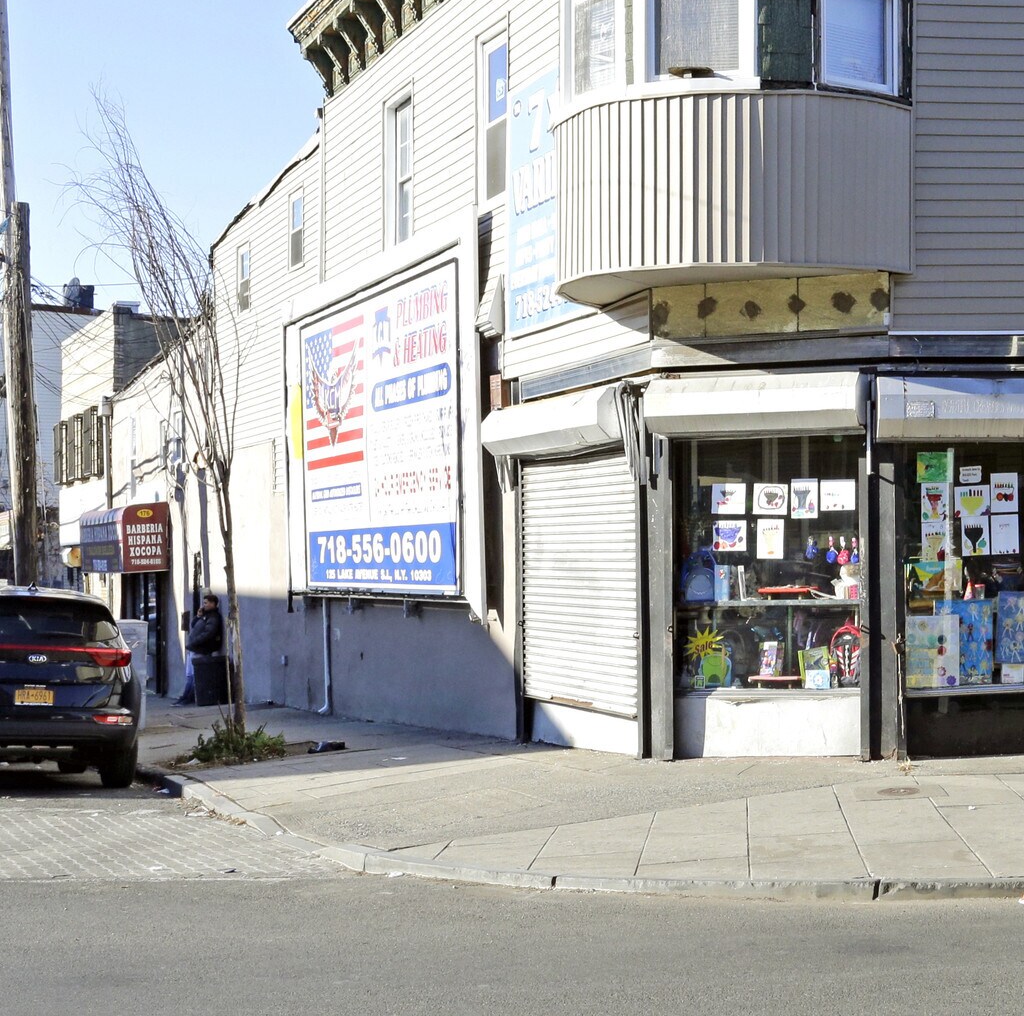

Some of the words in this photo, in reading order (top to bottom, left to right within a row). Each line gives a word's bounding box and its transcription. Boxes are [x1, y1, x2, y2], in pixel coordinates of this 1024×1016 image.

[403, 320, 448, 365] HEATING
[126, 523, 163, 534] BARBERIA
[128, 535, 162, 546] HISPANA
[130, 546, 162, 557] XOCOPA
[318, 530, 442, 564] 718-556-0600
[337, 568, 354, 580] LAKE
